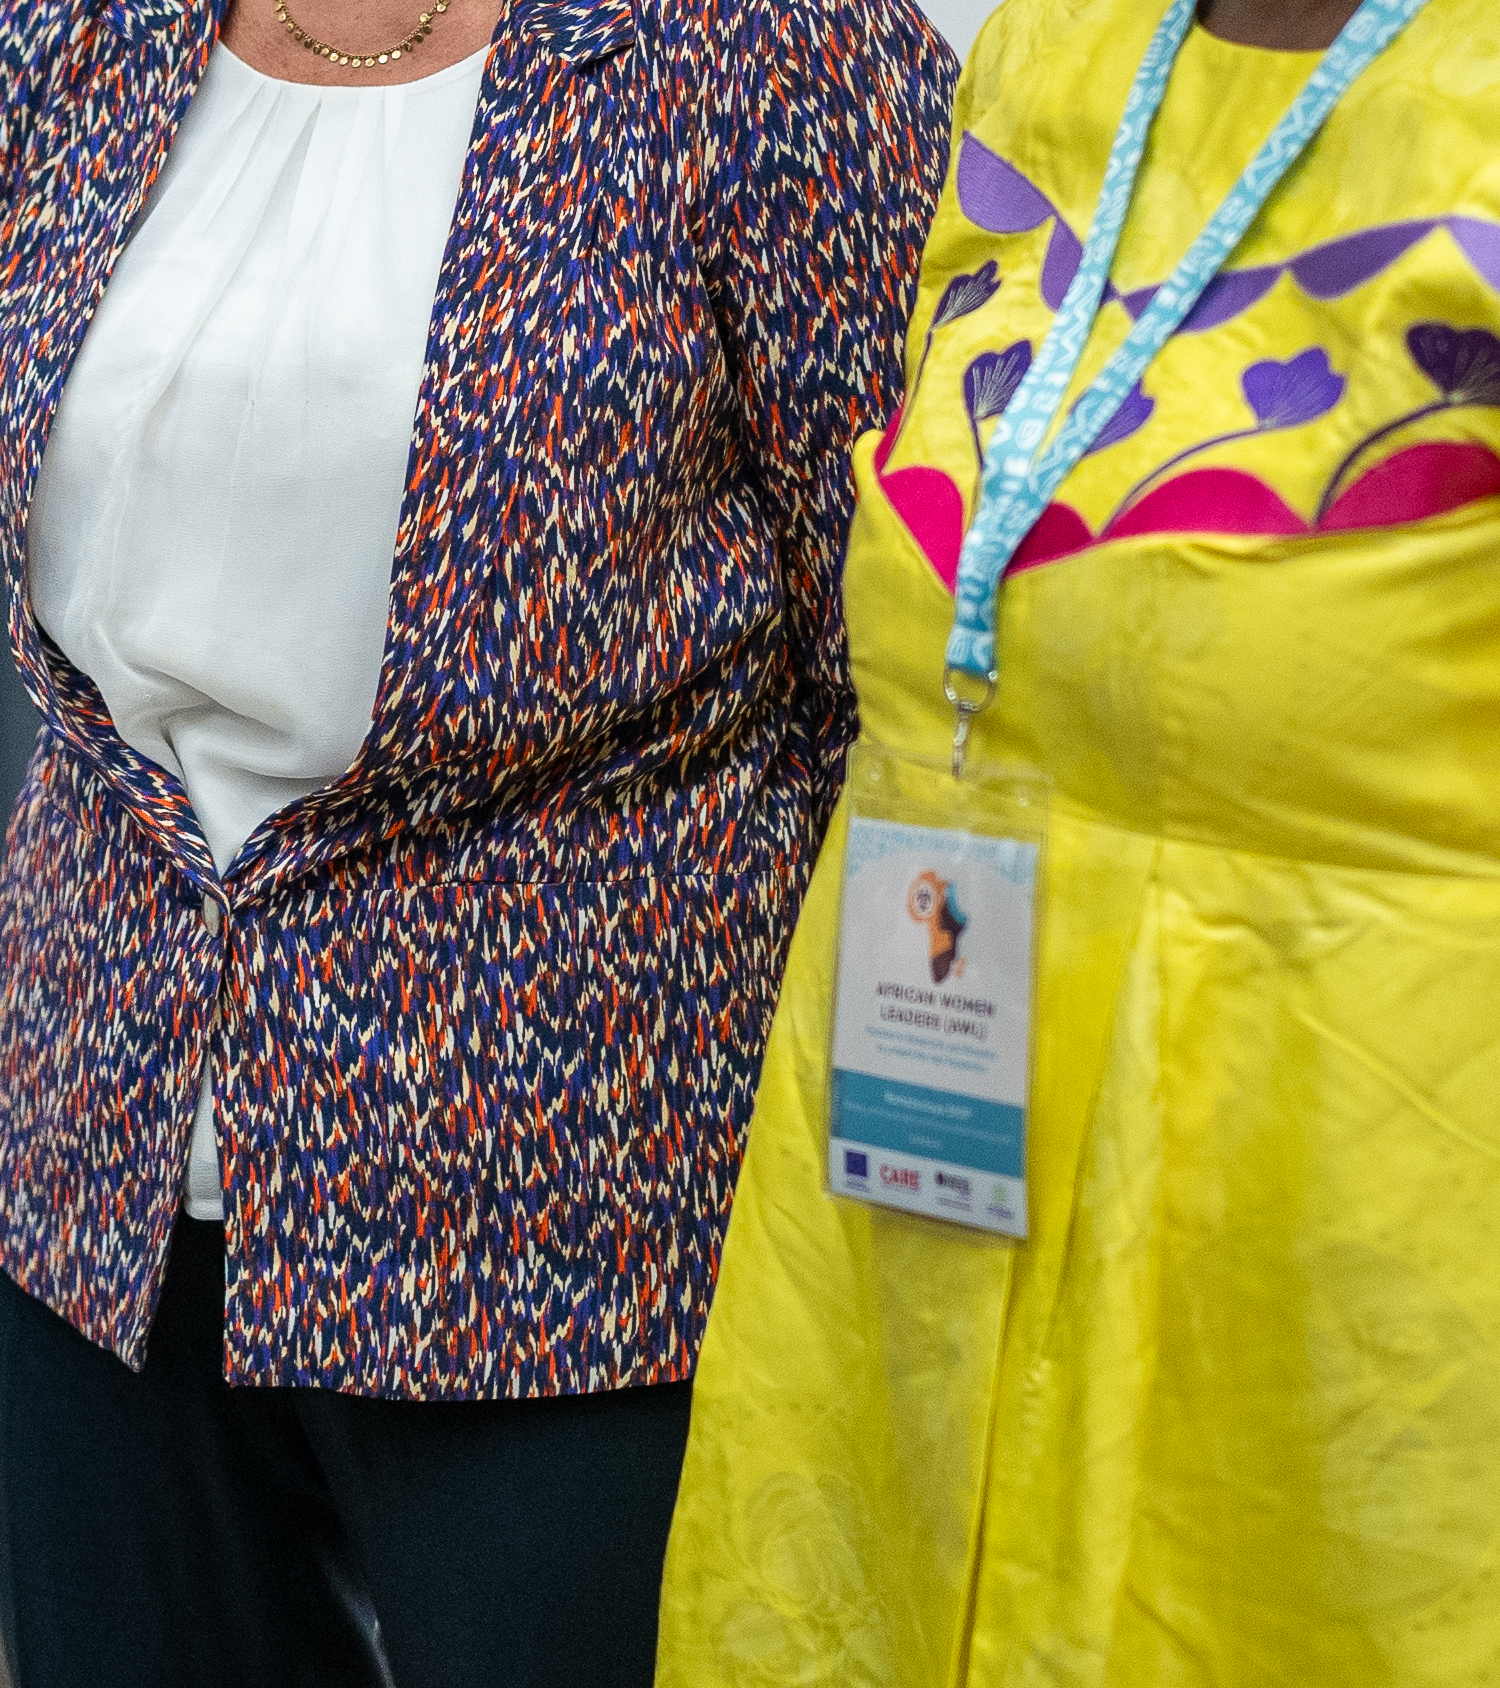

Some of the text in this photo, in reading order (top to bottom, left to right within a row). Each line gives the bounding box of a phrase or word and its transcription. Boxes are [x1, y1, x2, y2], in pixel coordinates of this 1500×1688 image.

[876, 981, 996, 1018] AFRICAN WOMEN
[880, 1004, 941, 1031] LEADERS
[943, 1016, 988, 1043] (AWL)
[879, 1163, 921, 1191] CARE
